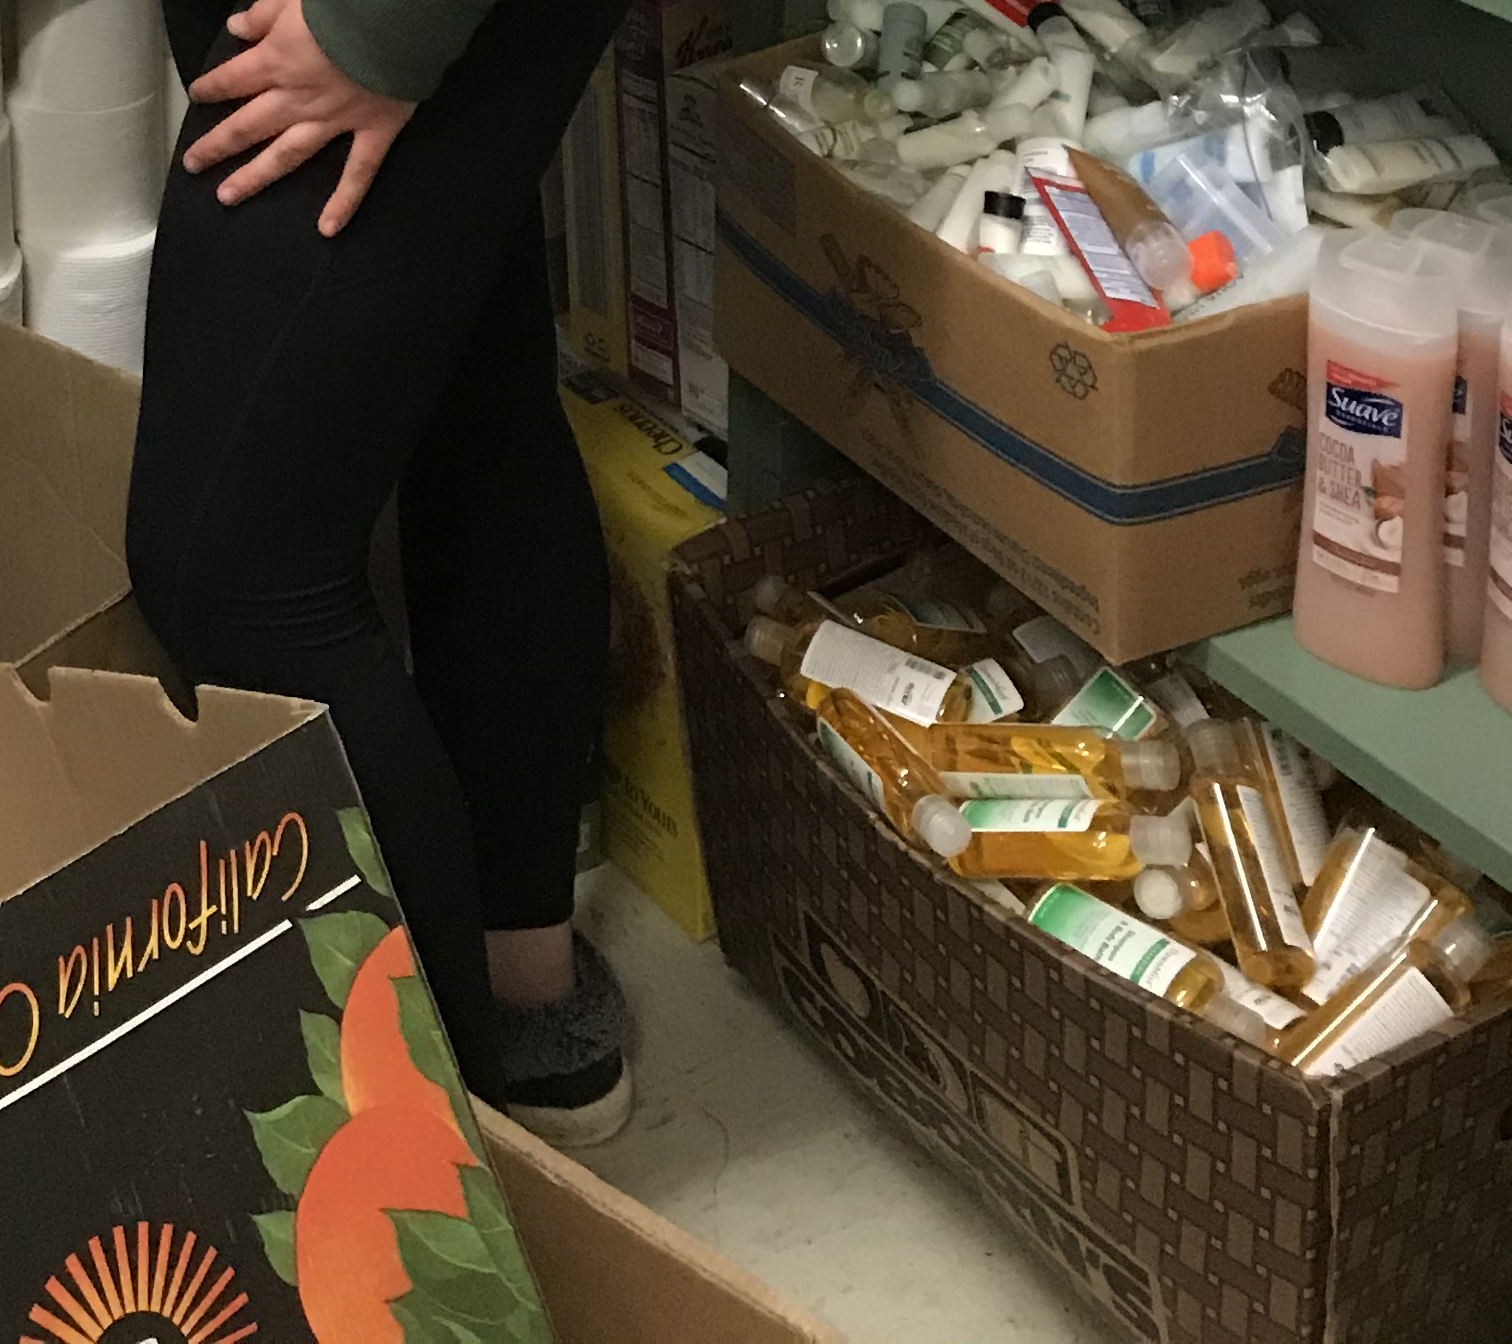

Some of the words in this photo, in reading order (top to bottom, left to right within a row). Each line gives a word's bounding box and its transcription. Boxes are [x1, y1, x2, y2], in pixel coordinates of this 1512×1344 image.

[1327, 385, 1400, 428] Suave
[1318, 432, 1356, 465] COCOA
[1317, 453, 1363, 488] BUTTER
[1329, 482, 1363, 512] SHEA
[56, 809, 311, 1023] California
[1107, 929, 1137, 963] Shampoo
